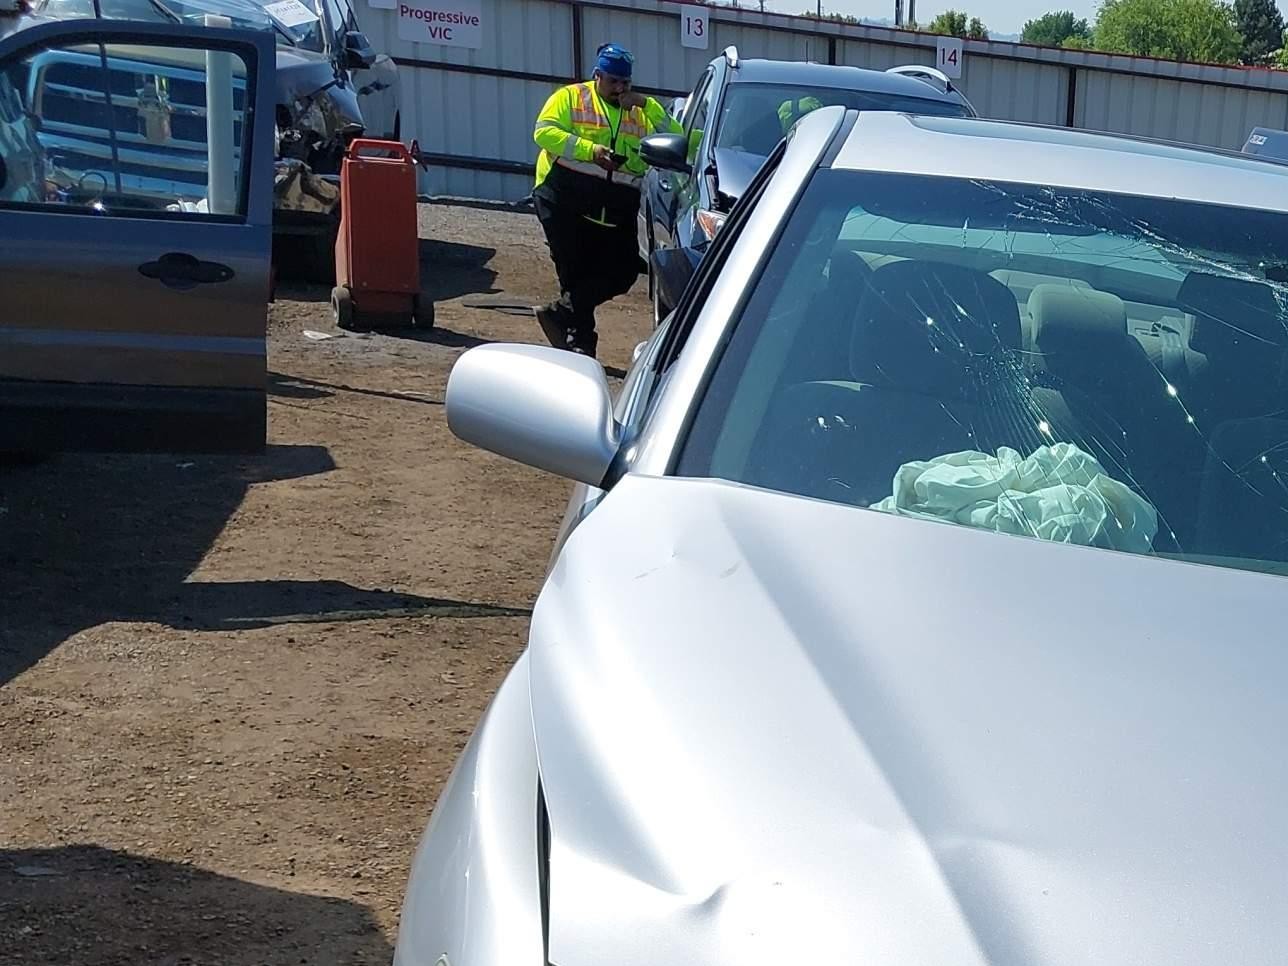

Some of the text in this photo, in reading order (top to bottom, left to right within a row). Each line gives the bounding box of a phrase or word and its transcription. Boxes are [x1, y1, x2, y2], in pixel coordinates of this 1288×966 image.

[400, 4, 480, 26] Progressive
[428, 26, 453, 41] VIC
[686, 16, 704, 37] 13
[941, 47, 958, 67] 14
